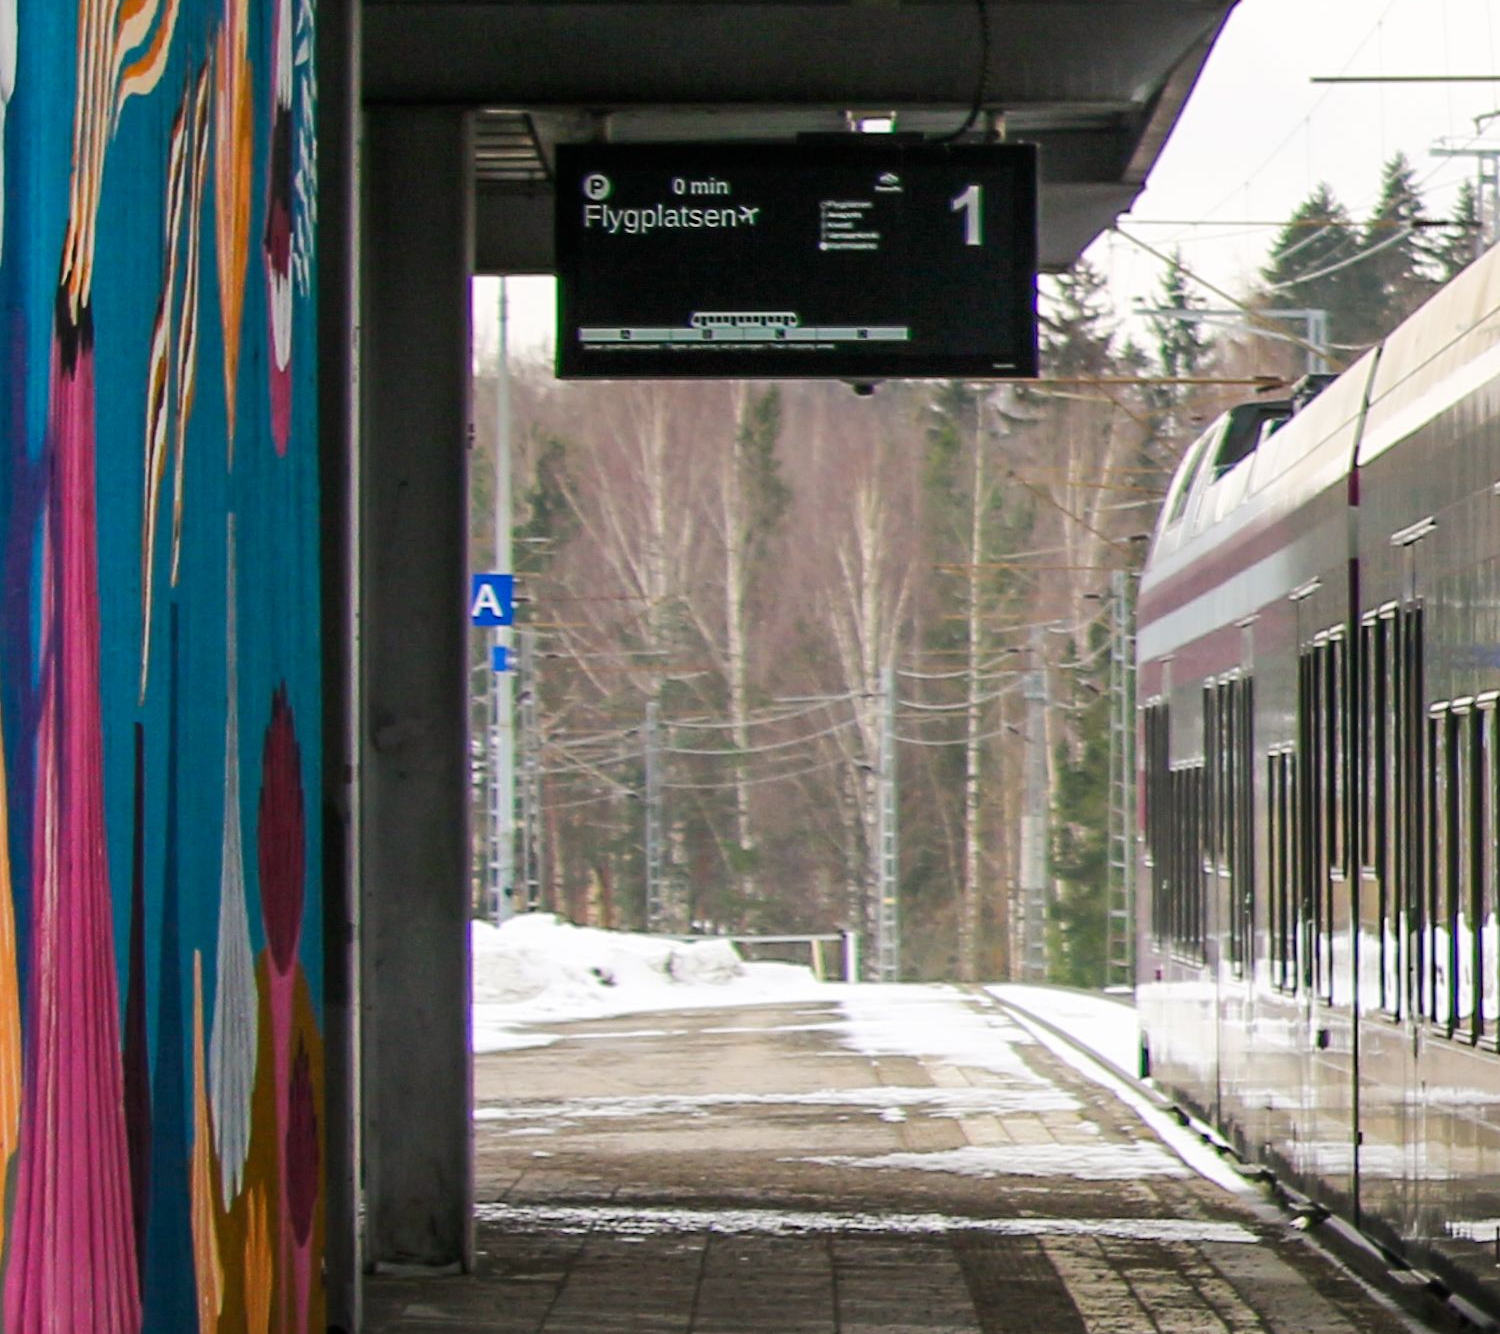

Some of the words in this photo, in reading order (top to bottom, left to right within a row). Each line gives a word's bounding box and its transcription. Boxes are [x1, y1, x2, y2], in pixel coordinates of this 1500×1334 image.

[672, 178, 685, 195] 0
[690, 177, 730, 195] min
[584, 203, 737, 233] Flygplatsen
[951, 184, 984, 246] 1
[471, 582, 504, 618] A
